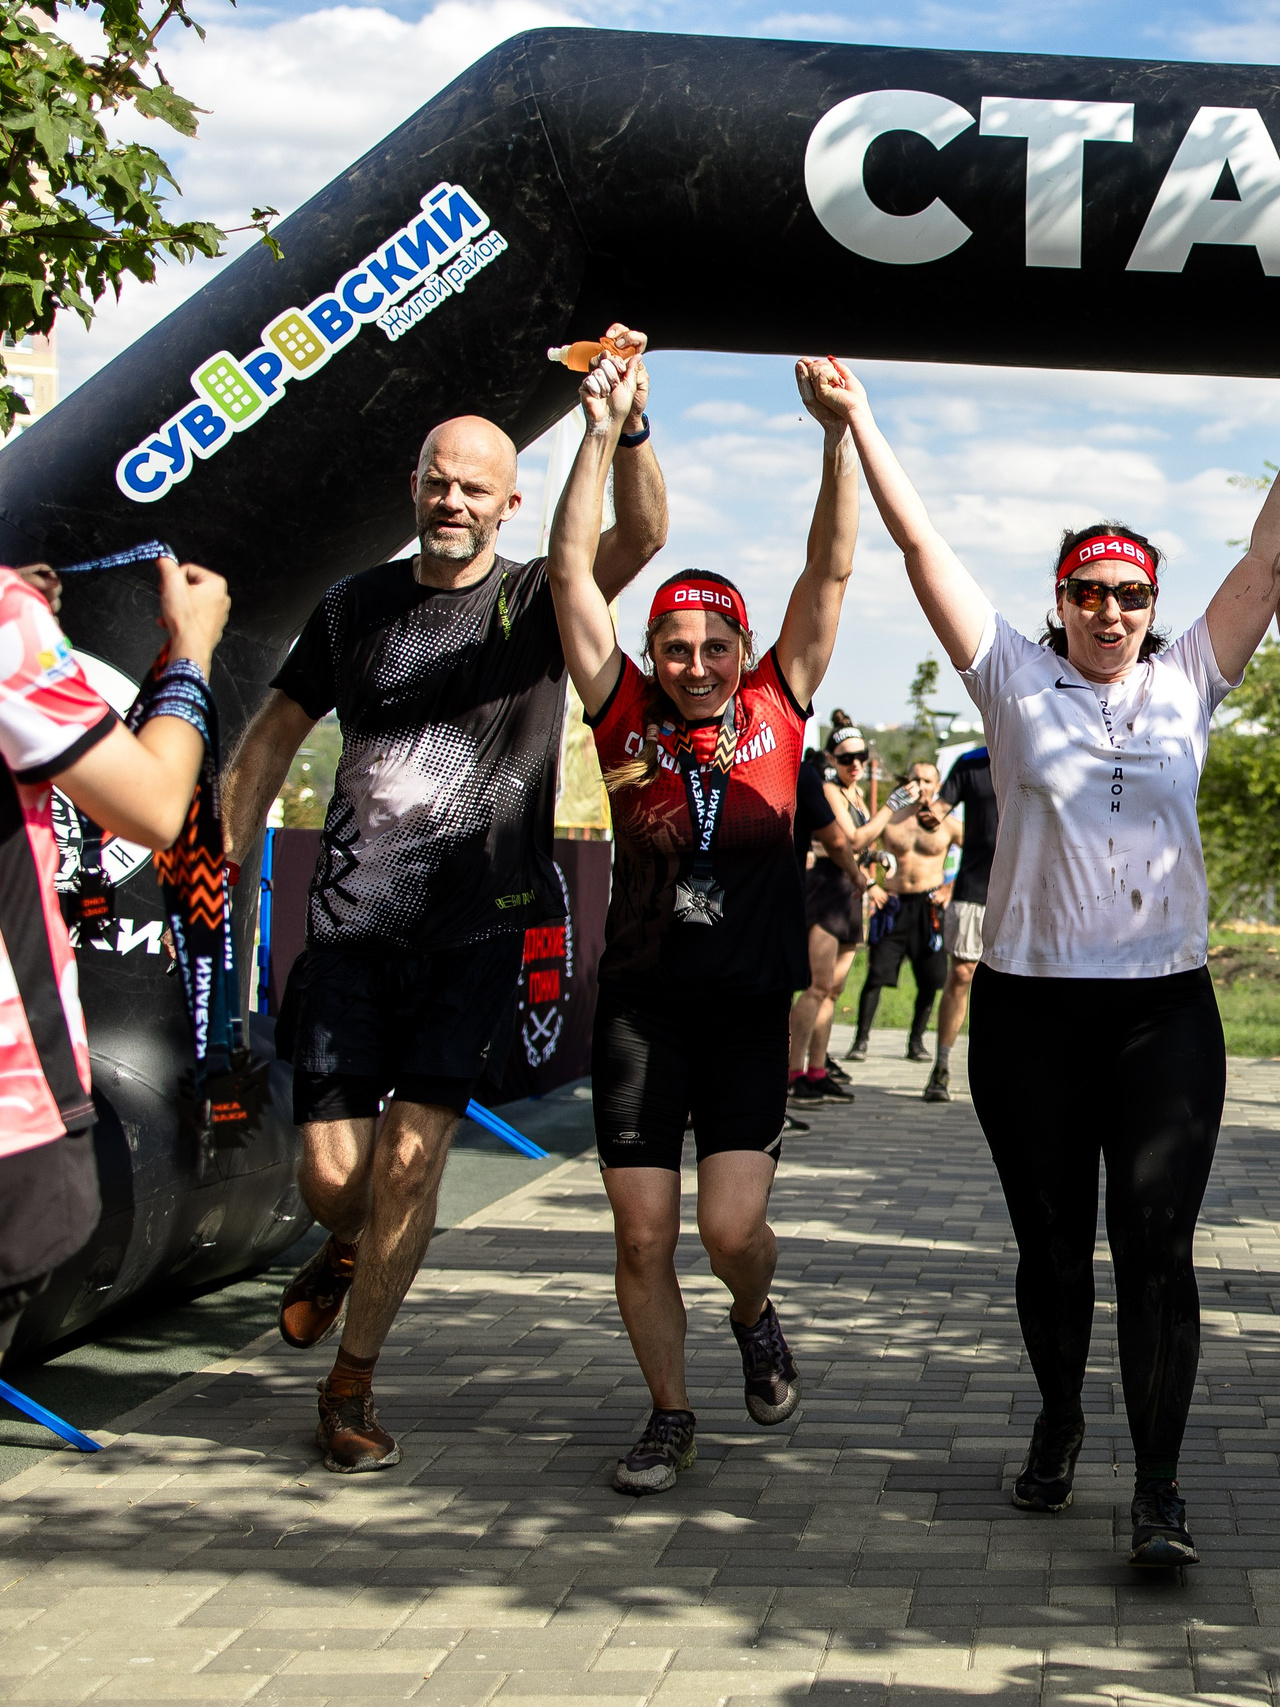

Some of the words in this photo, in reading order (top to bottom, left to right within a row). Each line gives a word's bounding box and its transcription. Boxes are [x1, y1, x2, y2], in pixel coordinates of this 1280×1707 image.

[381, 276, 449, 336] Жилой
[447, 233, 504, 287] район
[1079, 541, 1145, 565] 02488
[674, 589, 732, 609] 02510
[700, 788, 721, 851] КАЗАКИ
[196, 956, 213, 1059] КАЗАКИ
[529, 969, 560, 1004] ГОНКИ
